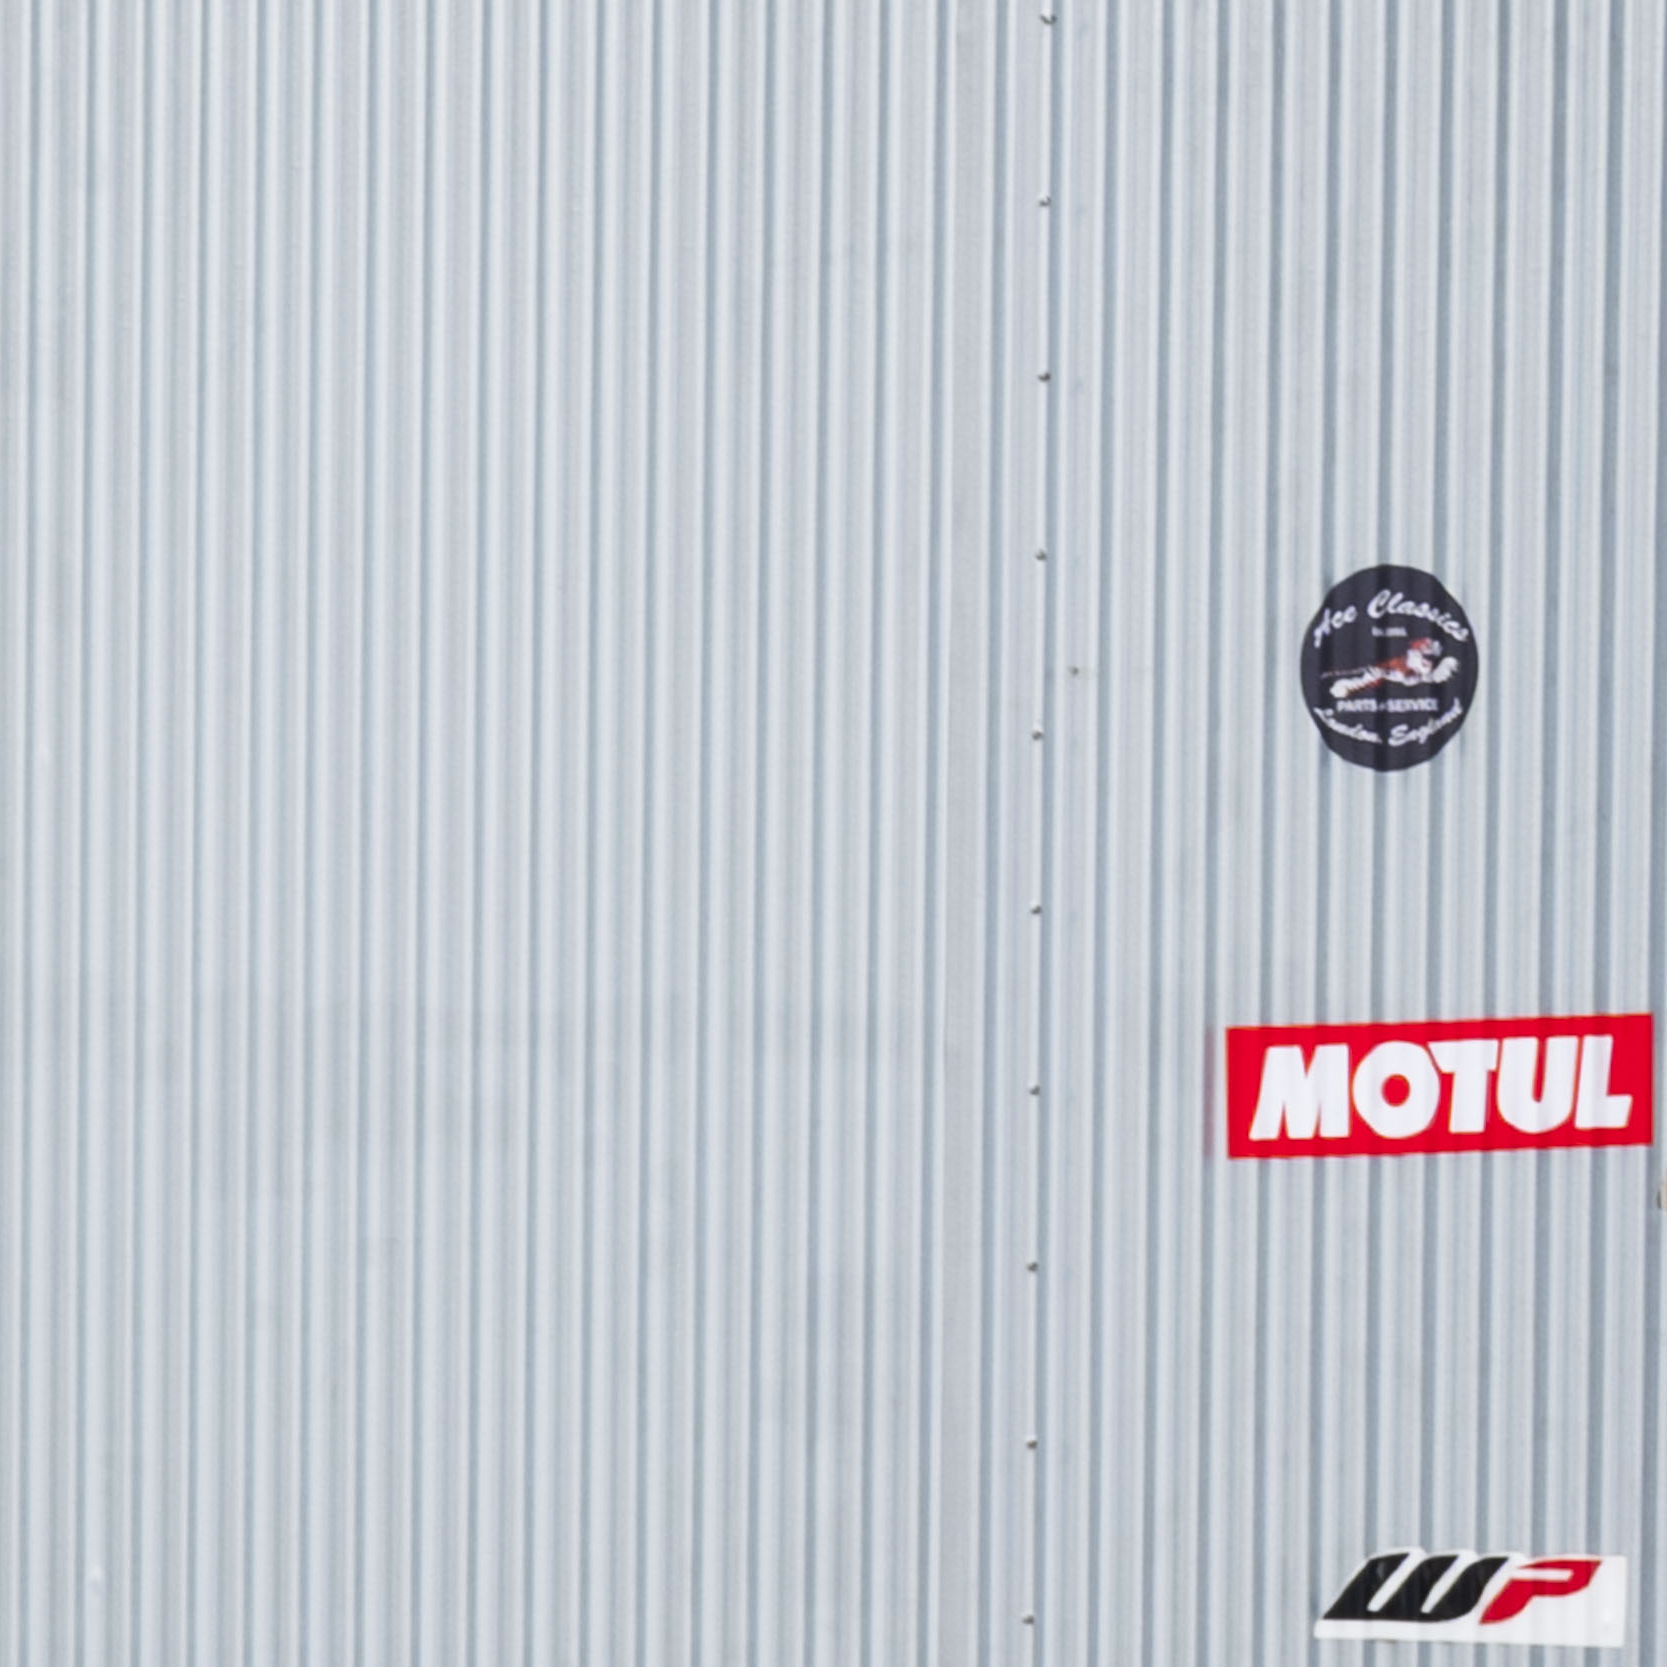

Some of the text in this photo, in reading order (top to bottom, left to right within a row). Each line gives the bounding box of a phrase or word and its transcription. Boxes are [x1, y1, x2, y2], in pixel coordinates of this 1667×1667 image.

[1314, 589, 1469, 648] Ace Classics
[1249, 1035, 1633, 1141] MOTUL
[1323, 1552, 1602, 1625] WP
